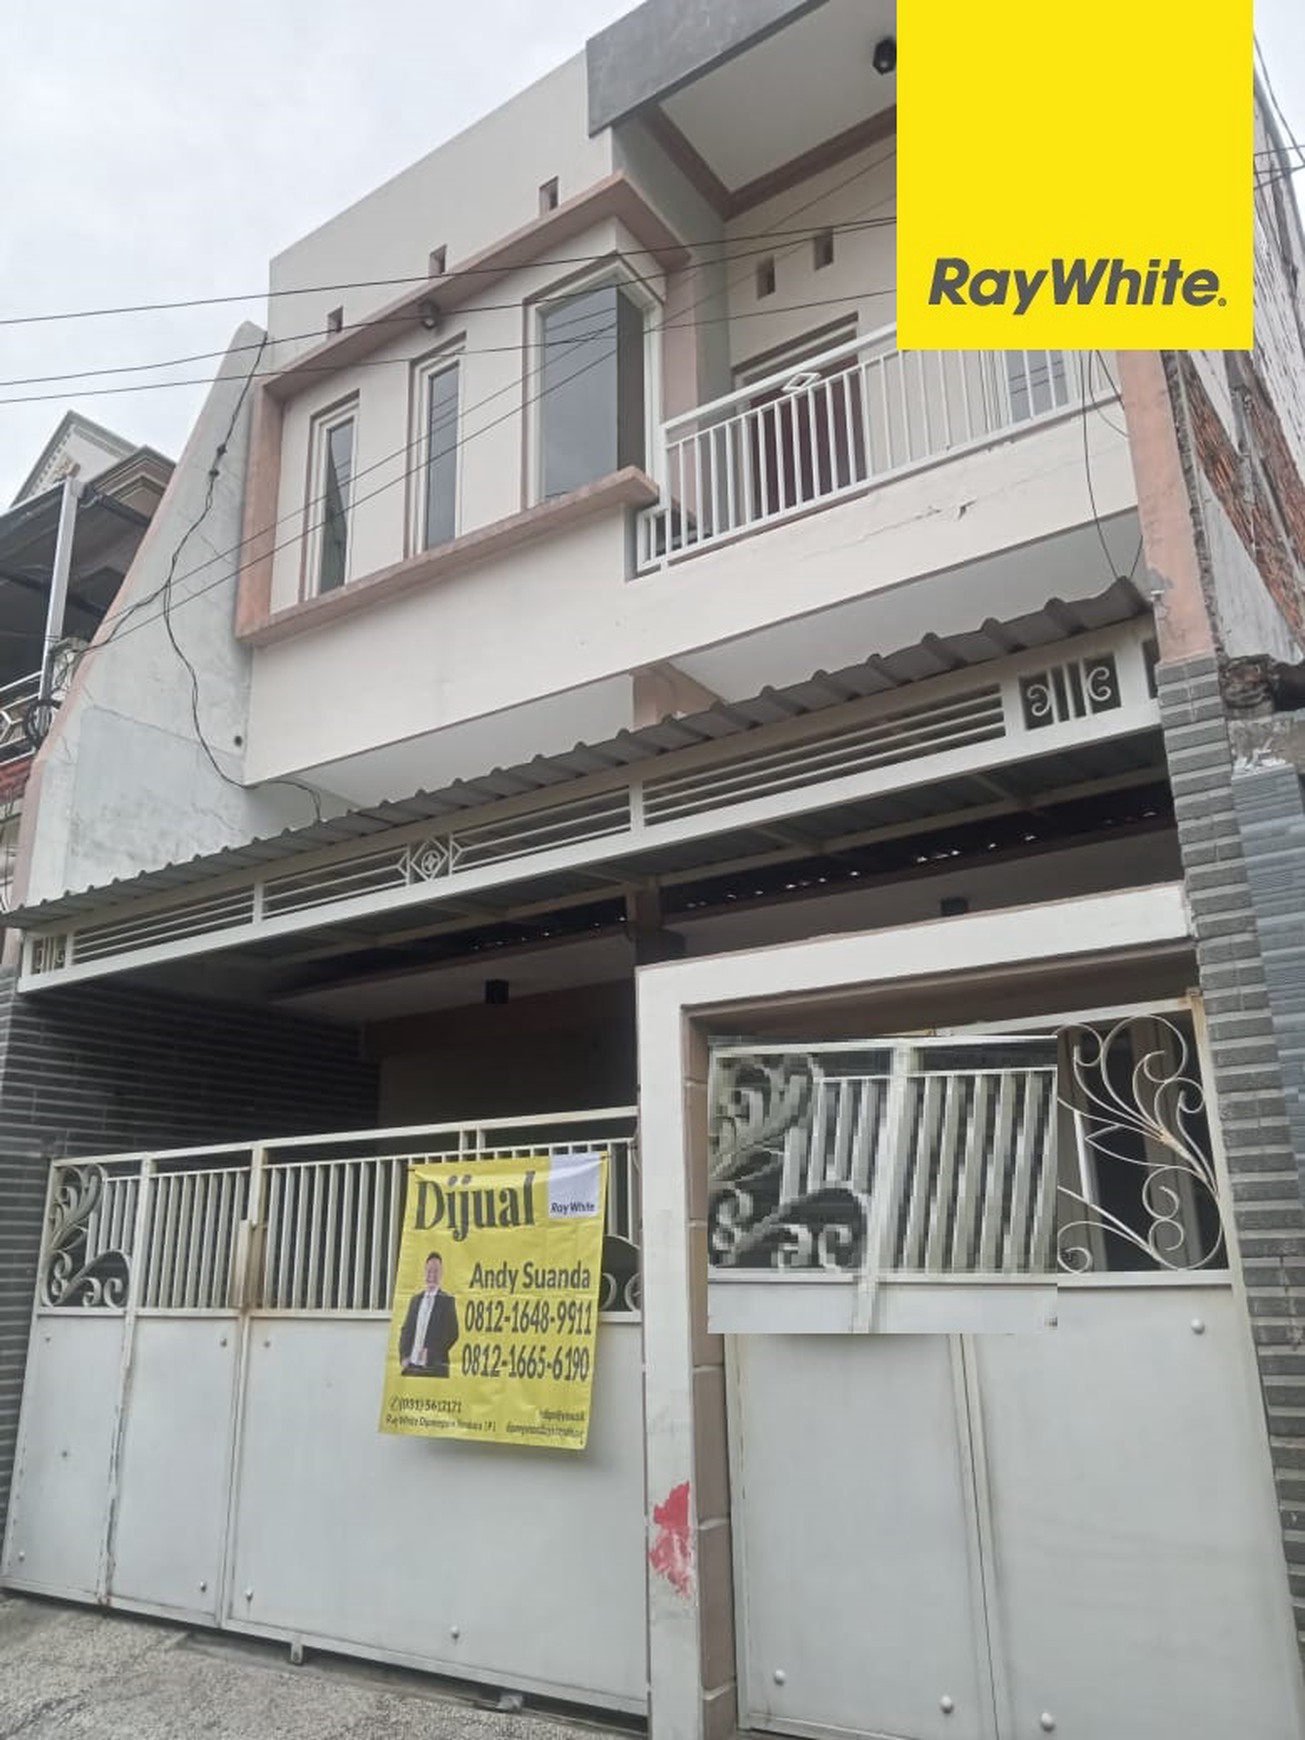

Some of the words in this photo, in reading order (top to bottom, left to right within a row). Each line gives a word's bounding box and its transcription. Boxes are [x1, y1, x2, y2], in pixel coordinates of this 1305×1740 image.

[414, 1170, 536, 1242] Dijual
[469, 1260, 519, 1293] Andy
[522, 1260, 591, 1290] Suanda
[465, 1299, 592, 1335] 0812-1648-9911
[461, 1343, 590, 1382] 0812-1665-6190
